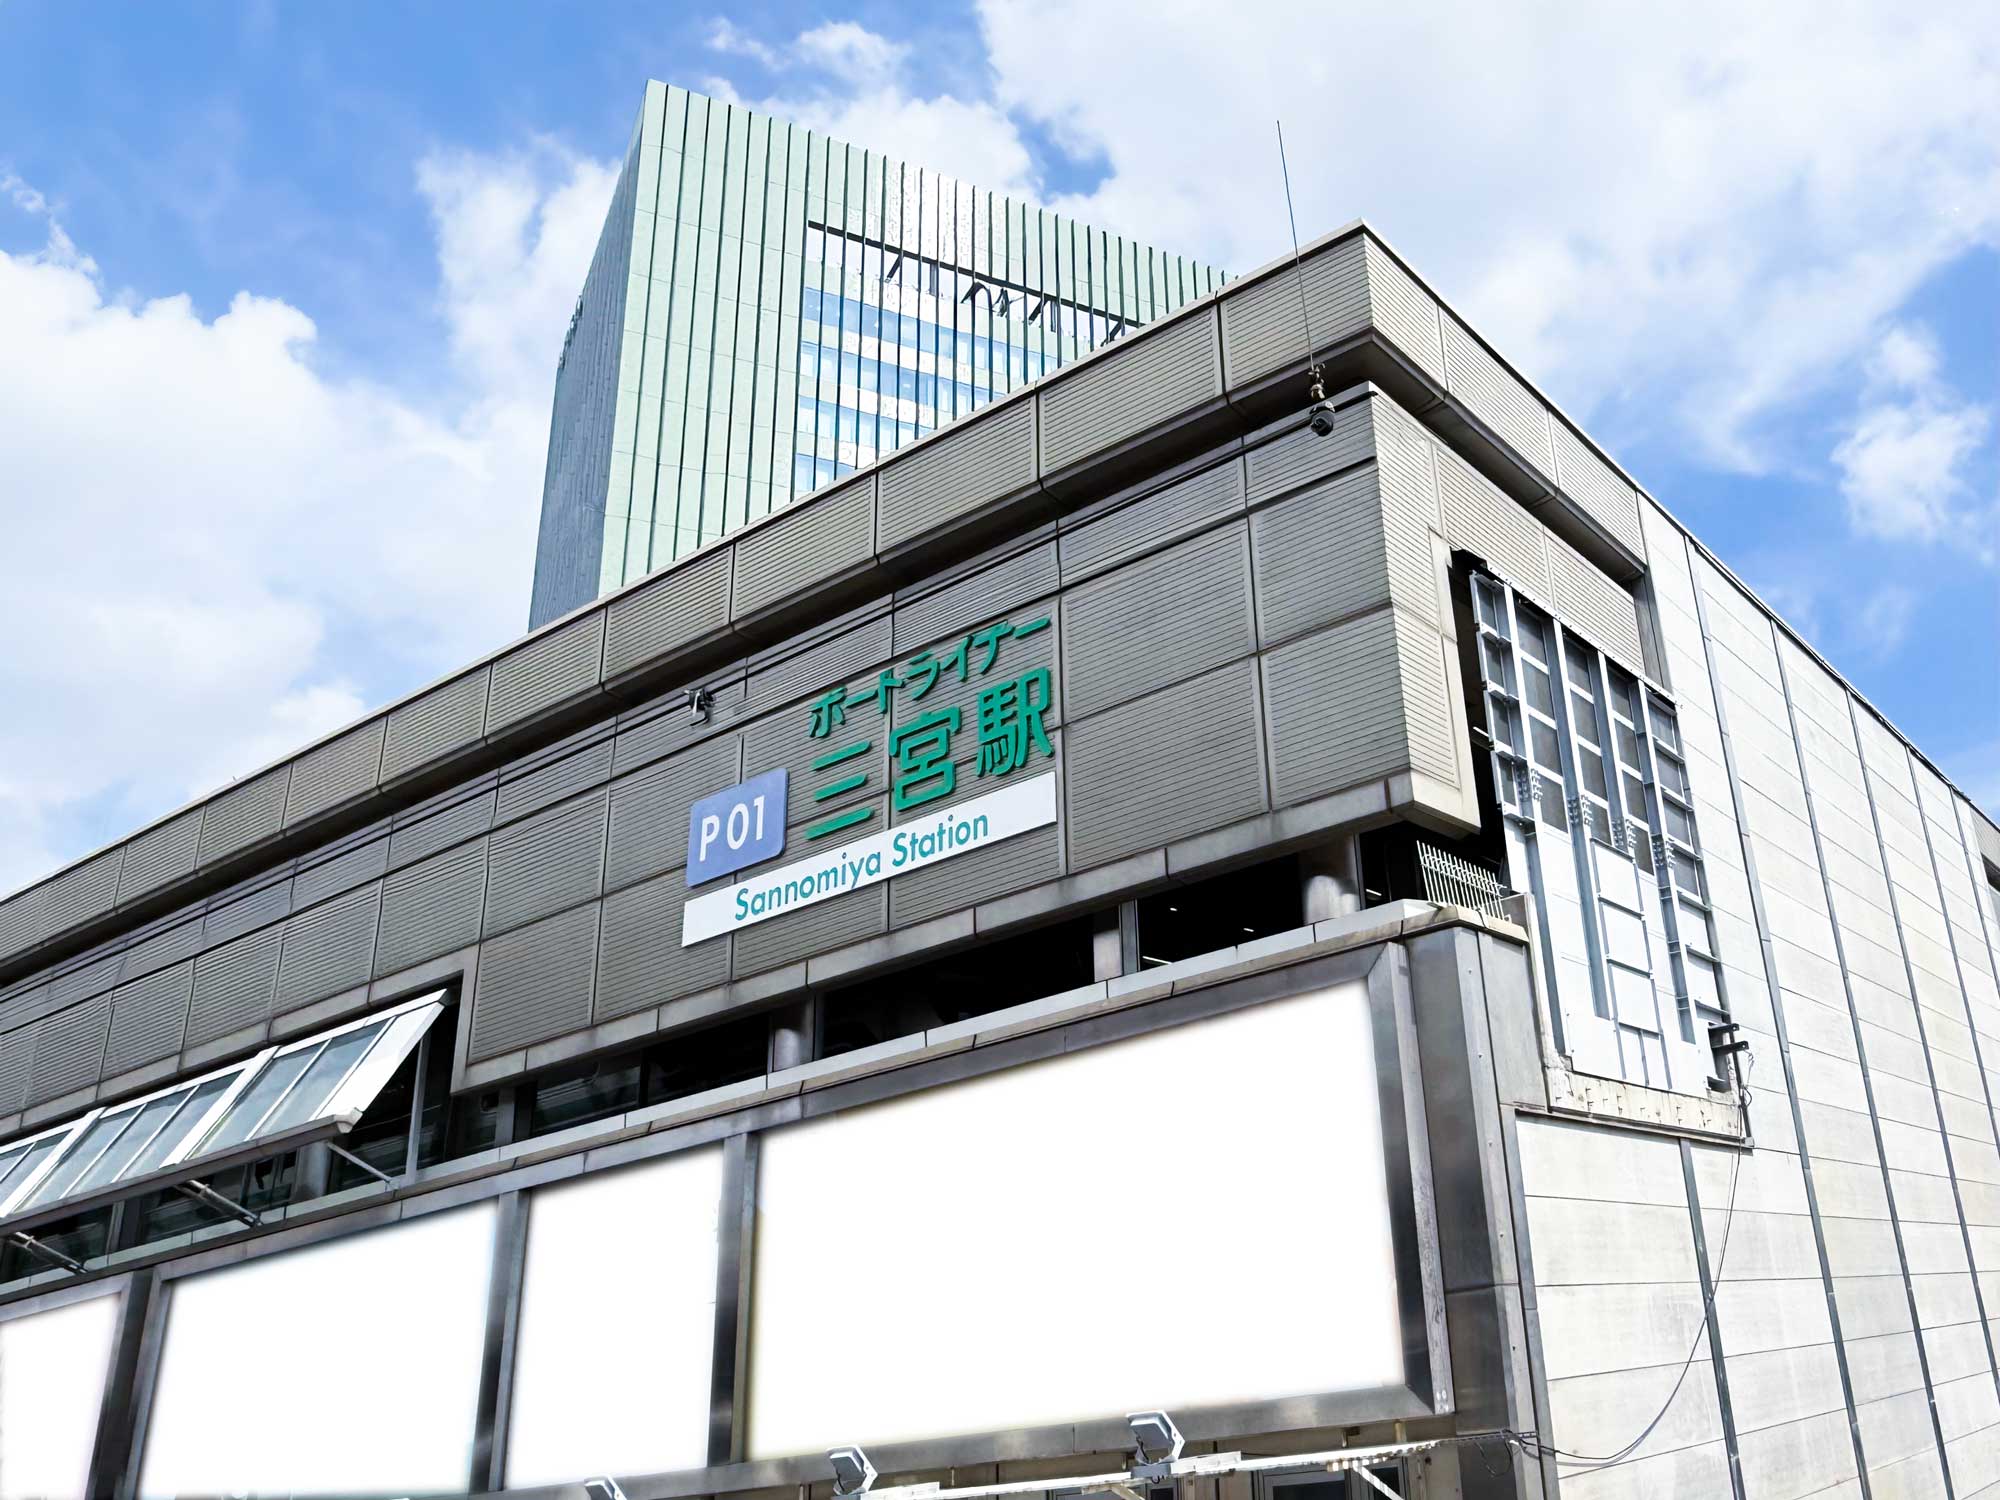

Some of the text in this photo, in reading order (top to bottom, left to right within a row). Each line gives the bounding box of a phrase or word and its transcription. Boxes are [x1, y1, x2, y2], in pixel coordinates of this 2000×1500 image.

[804, 666, 1056, 841] 三宮駅
[699, 795, 765, 862] P01
[735, 813, 989, 921] Sannomiya Station
